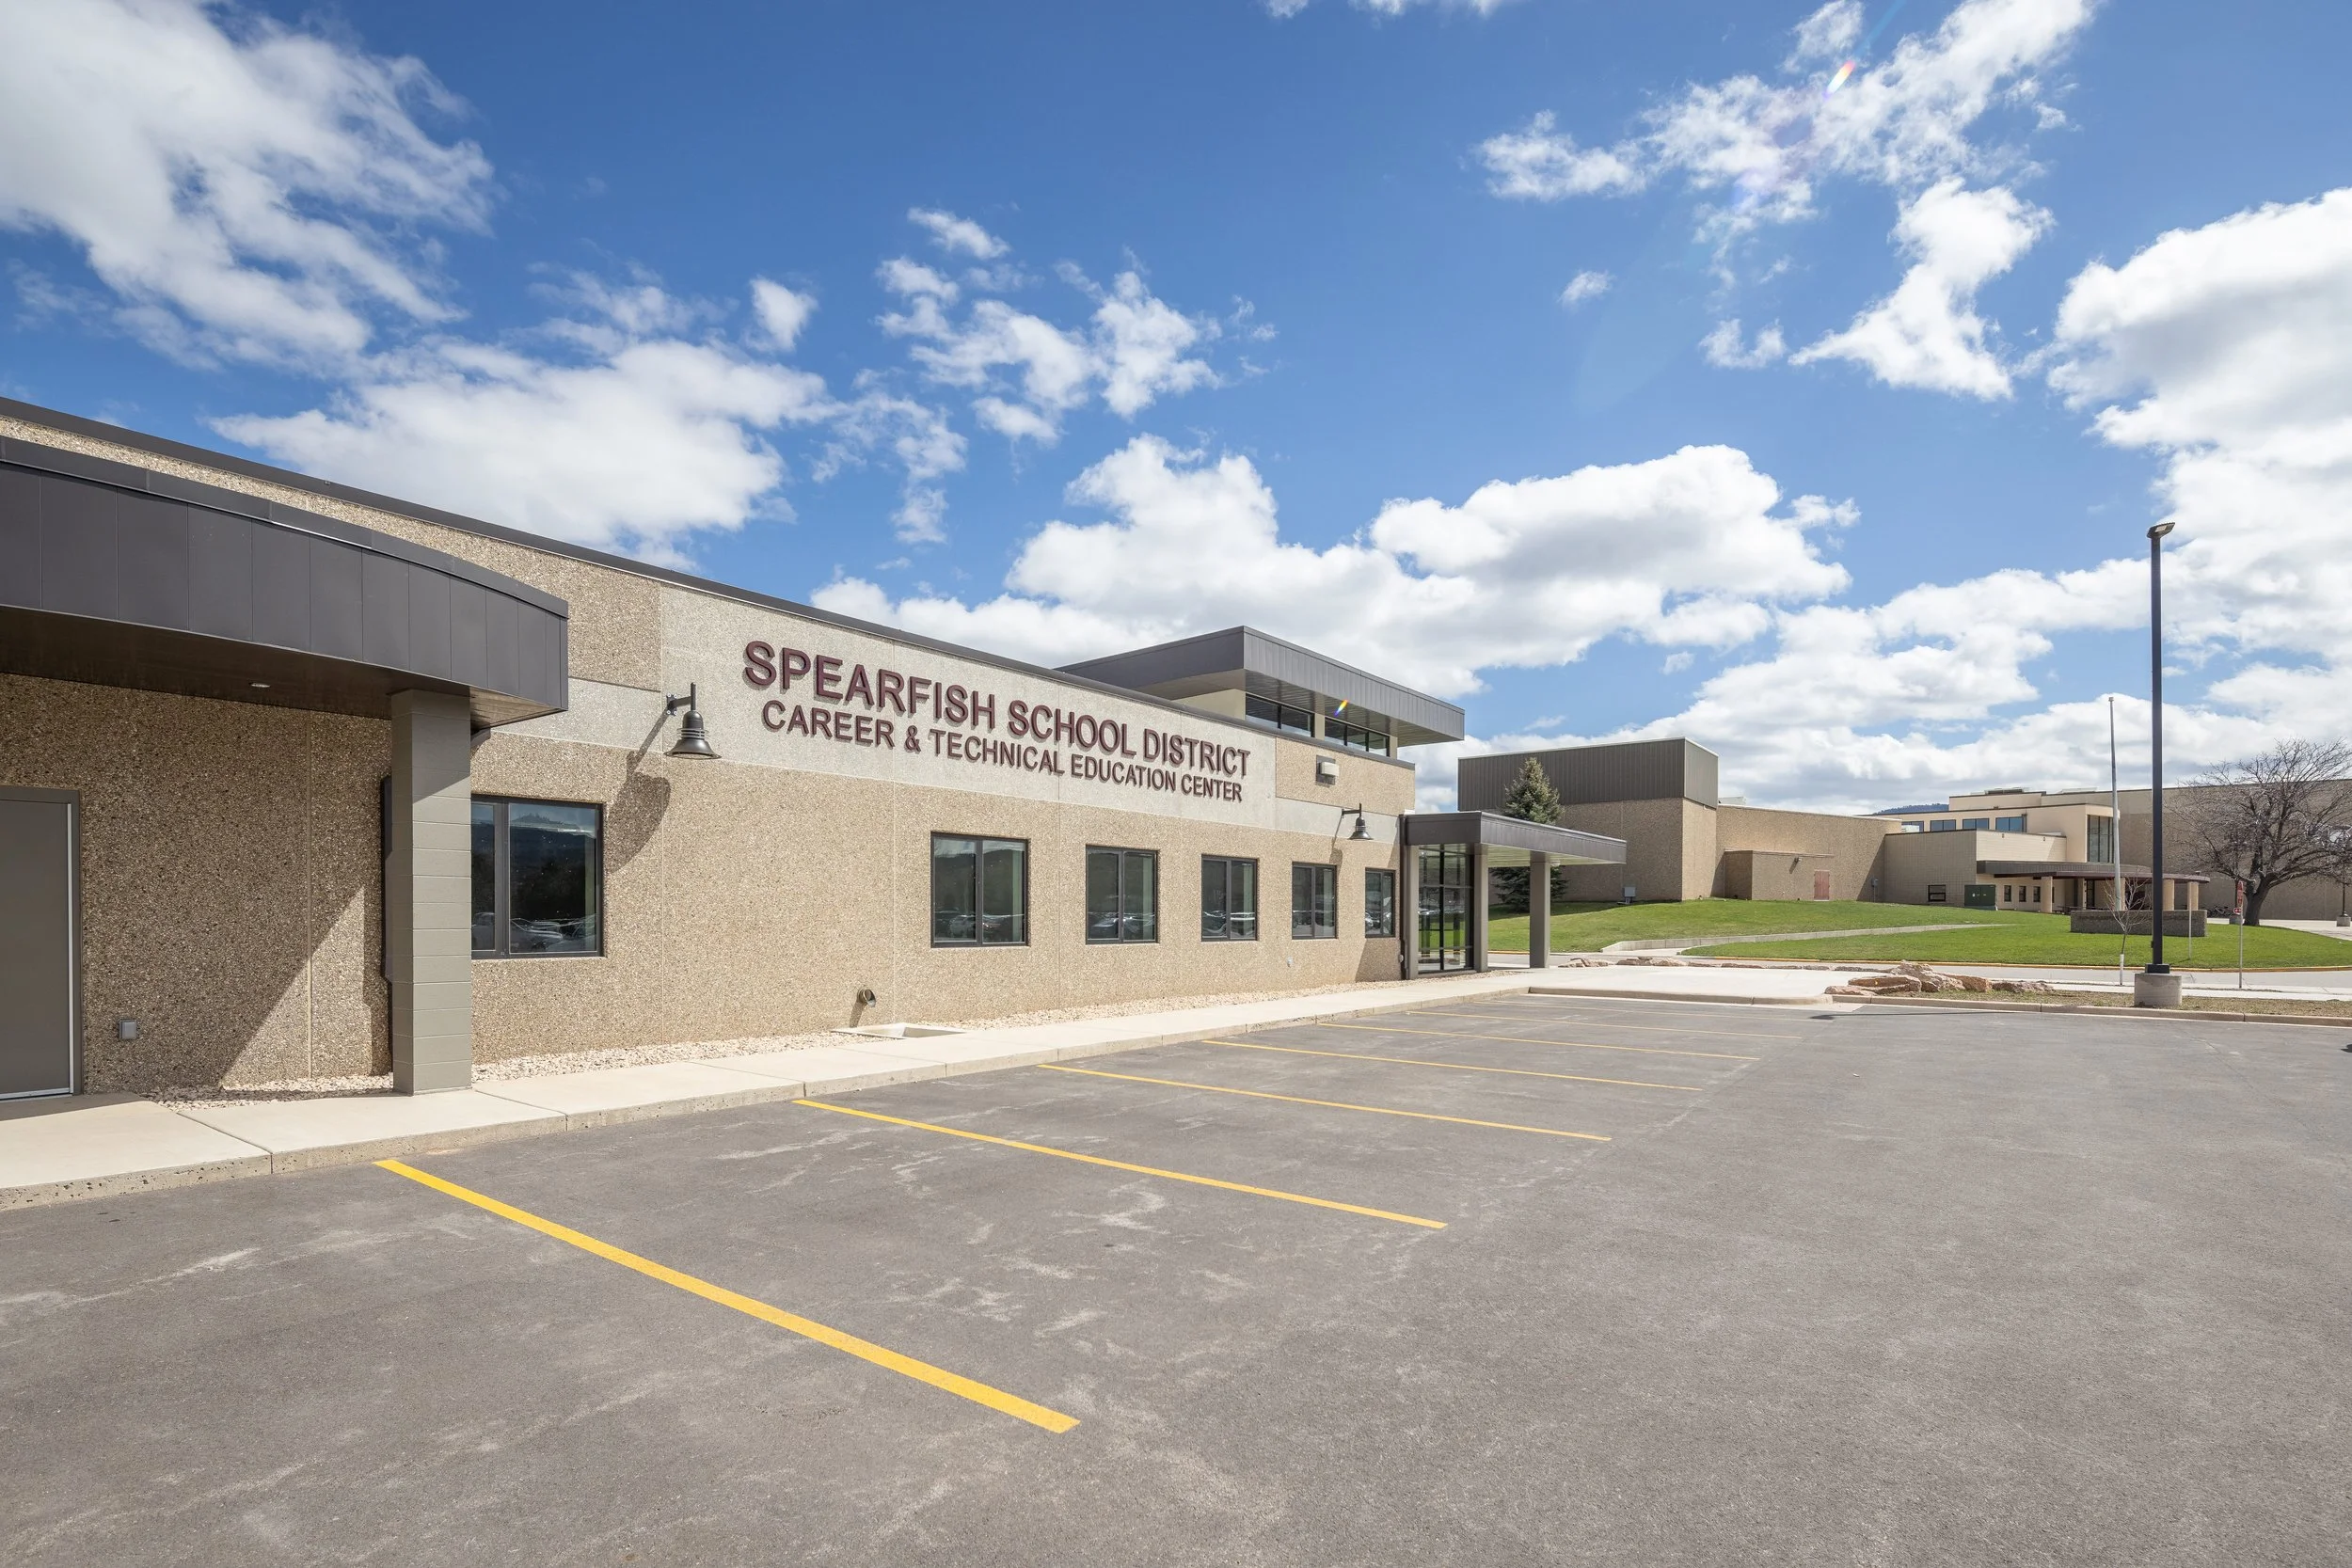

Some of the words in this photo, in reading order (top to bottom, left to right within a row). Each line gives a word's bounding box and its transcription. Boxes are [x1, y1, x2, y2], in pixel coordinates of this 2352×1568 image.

[744, 641, 995, 729] SPEARFISH
[1009, 700, 1136, 755] SCHOOL
[1144, 729, 1250, 776] DISTRICT
[763, 700, 895, 747] CAREER
[905, 725, 921, 752] &
[930, 729, 1065, 774] TECHNICAL
[1072, 754, 1176, 791] EDUCATION
[1181, 774, 1243, 801] CENTER
